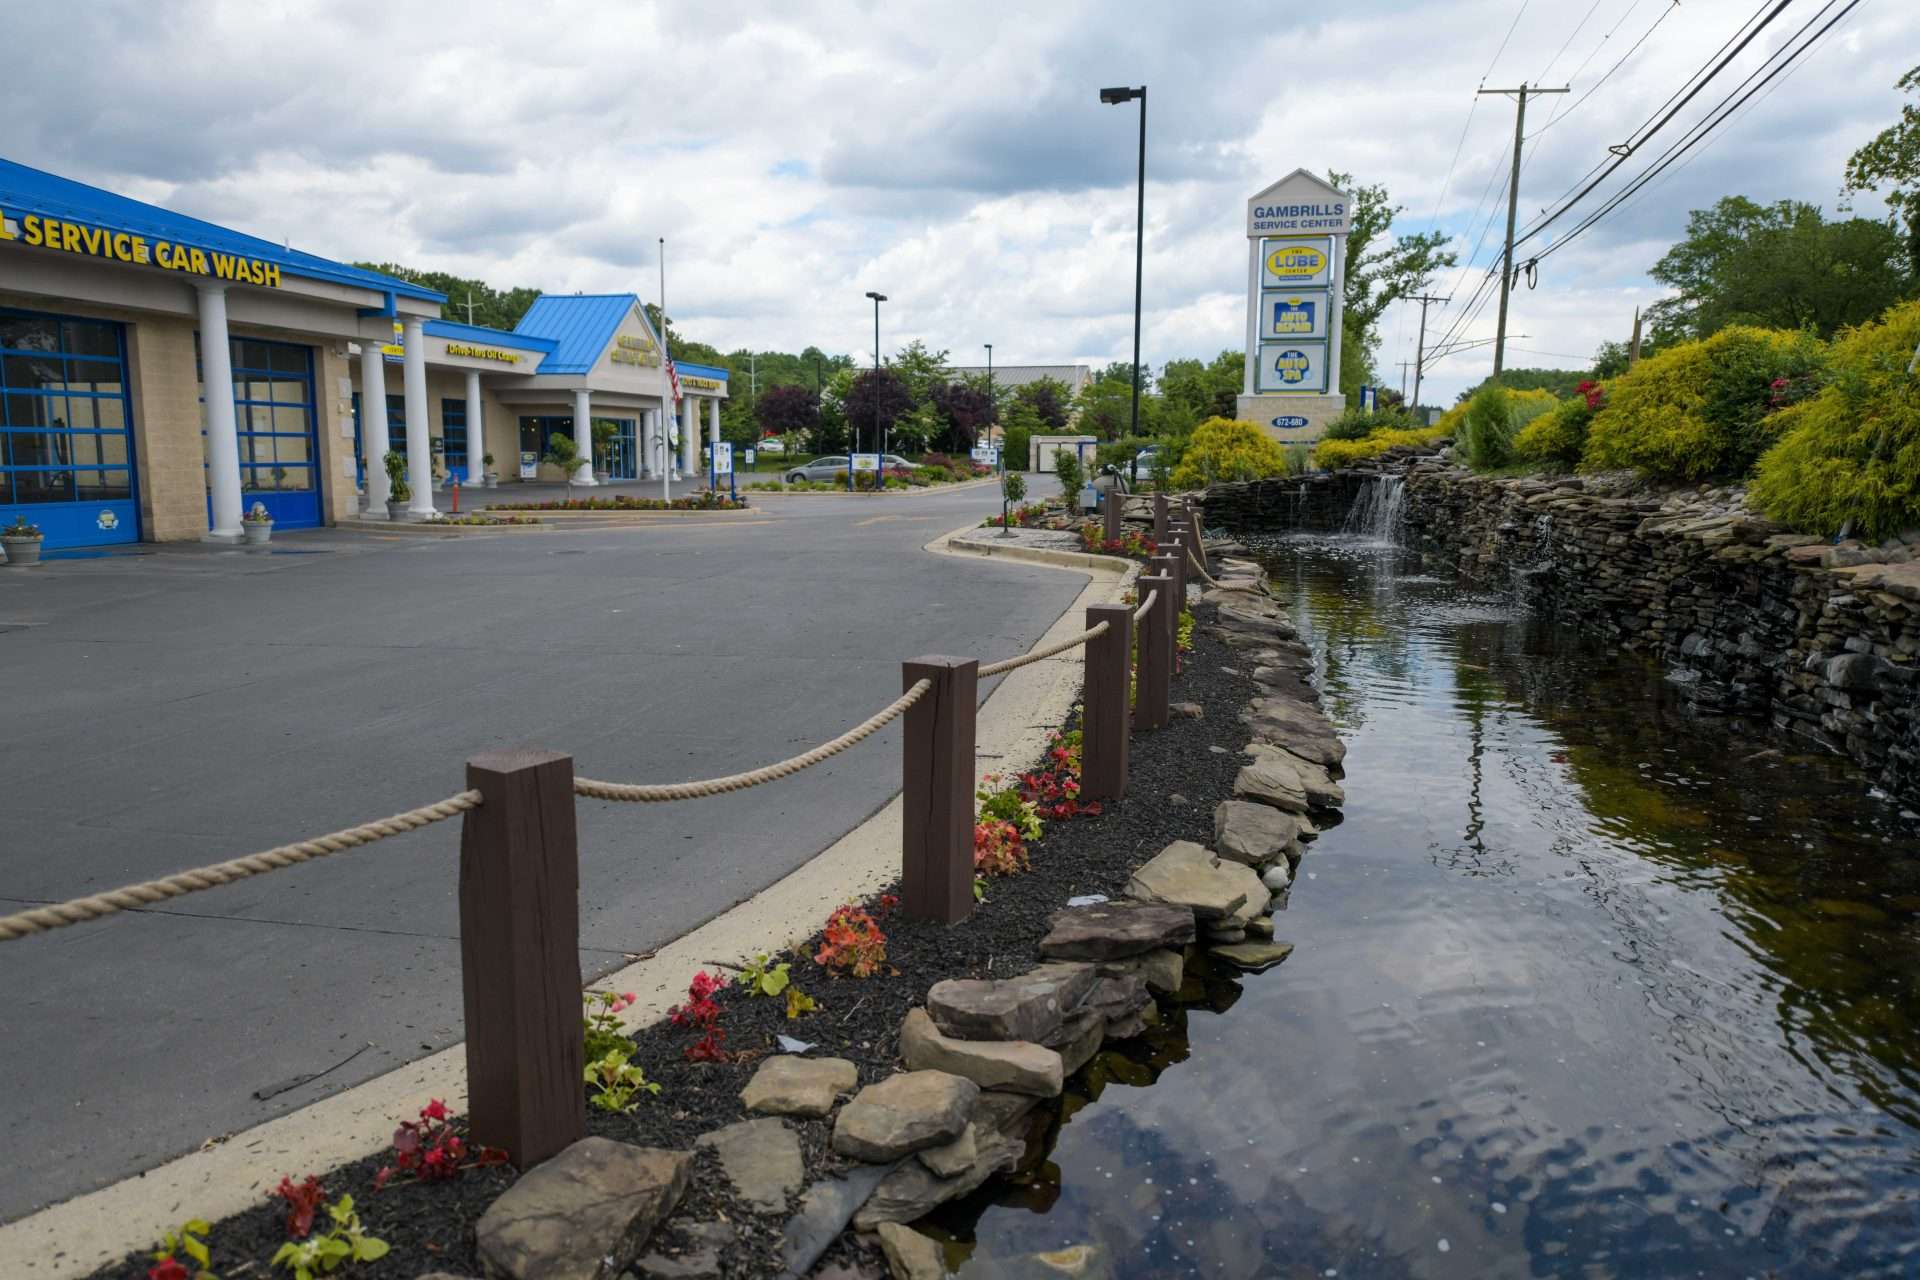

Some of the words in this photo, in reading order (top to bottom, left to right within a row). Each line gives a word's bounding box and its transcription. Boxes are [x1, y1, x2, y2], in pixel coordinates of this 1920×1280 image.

[1254, 204, 1344, 219] GAMBRILLS
[1253, 219, 1297, 230] SERVICE
[1300, 218, 1343, 229] CENTER
[23, 214, 148, 264] SERVICE
[155, 241, 208, 275] CAR
[211, 251, 281, 288] WASH
[1275, 254, 1319, 268] LUBE
